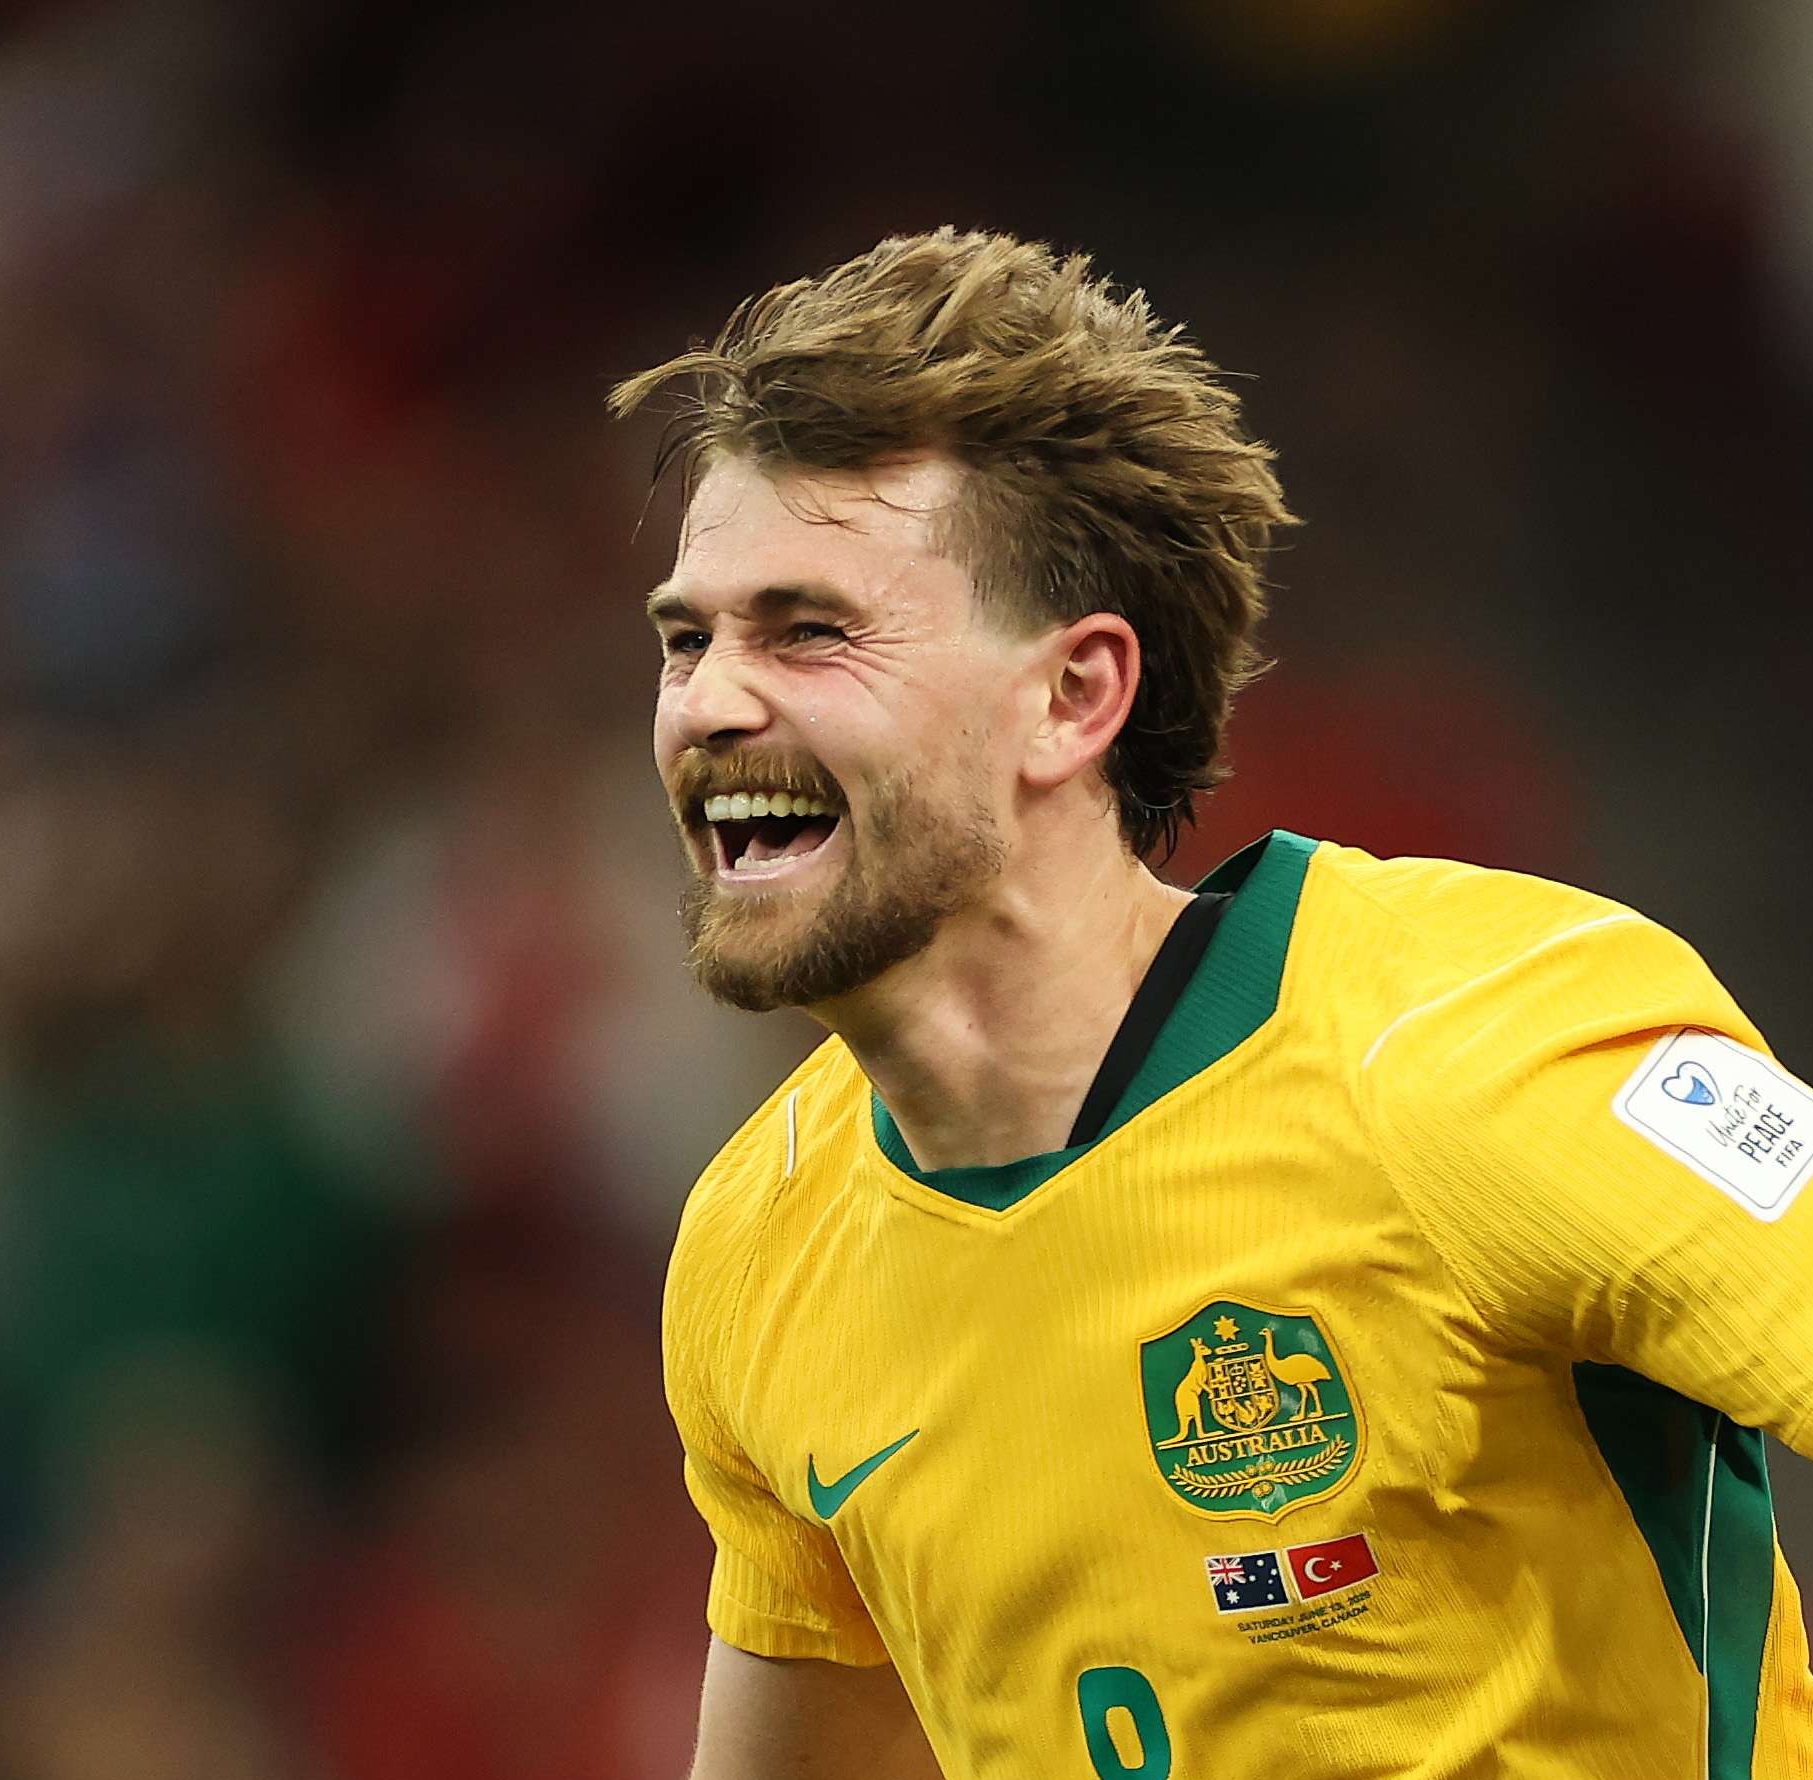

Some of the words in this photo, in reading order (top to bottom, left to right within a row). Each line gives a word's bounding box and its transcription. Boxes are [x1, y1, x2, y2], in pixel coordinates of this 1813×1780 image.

[1737, 1104, 1794, 1164] PEACE
[1775, 1140, 1803, 1168] FIFA
[1185, 1423, 1329, 1468] AUSTRALIA
[1237, 1615, 1295, 1632] SATURDAY
[1297, 1606, 1328, 1622] JUNE
[1249, 1623, 1320, 1644] VANCOUVER,
[1321, 1604, 1369, 1628] CANADA
